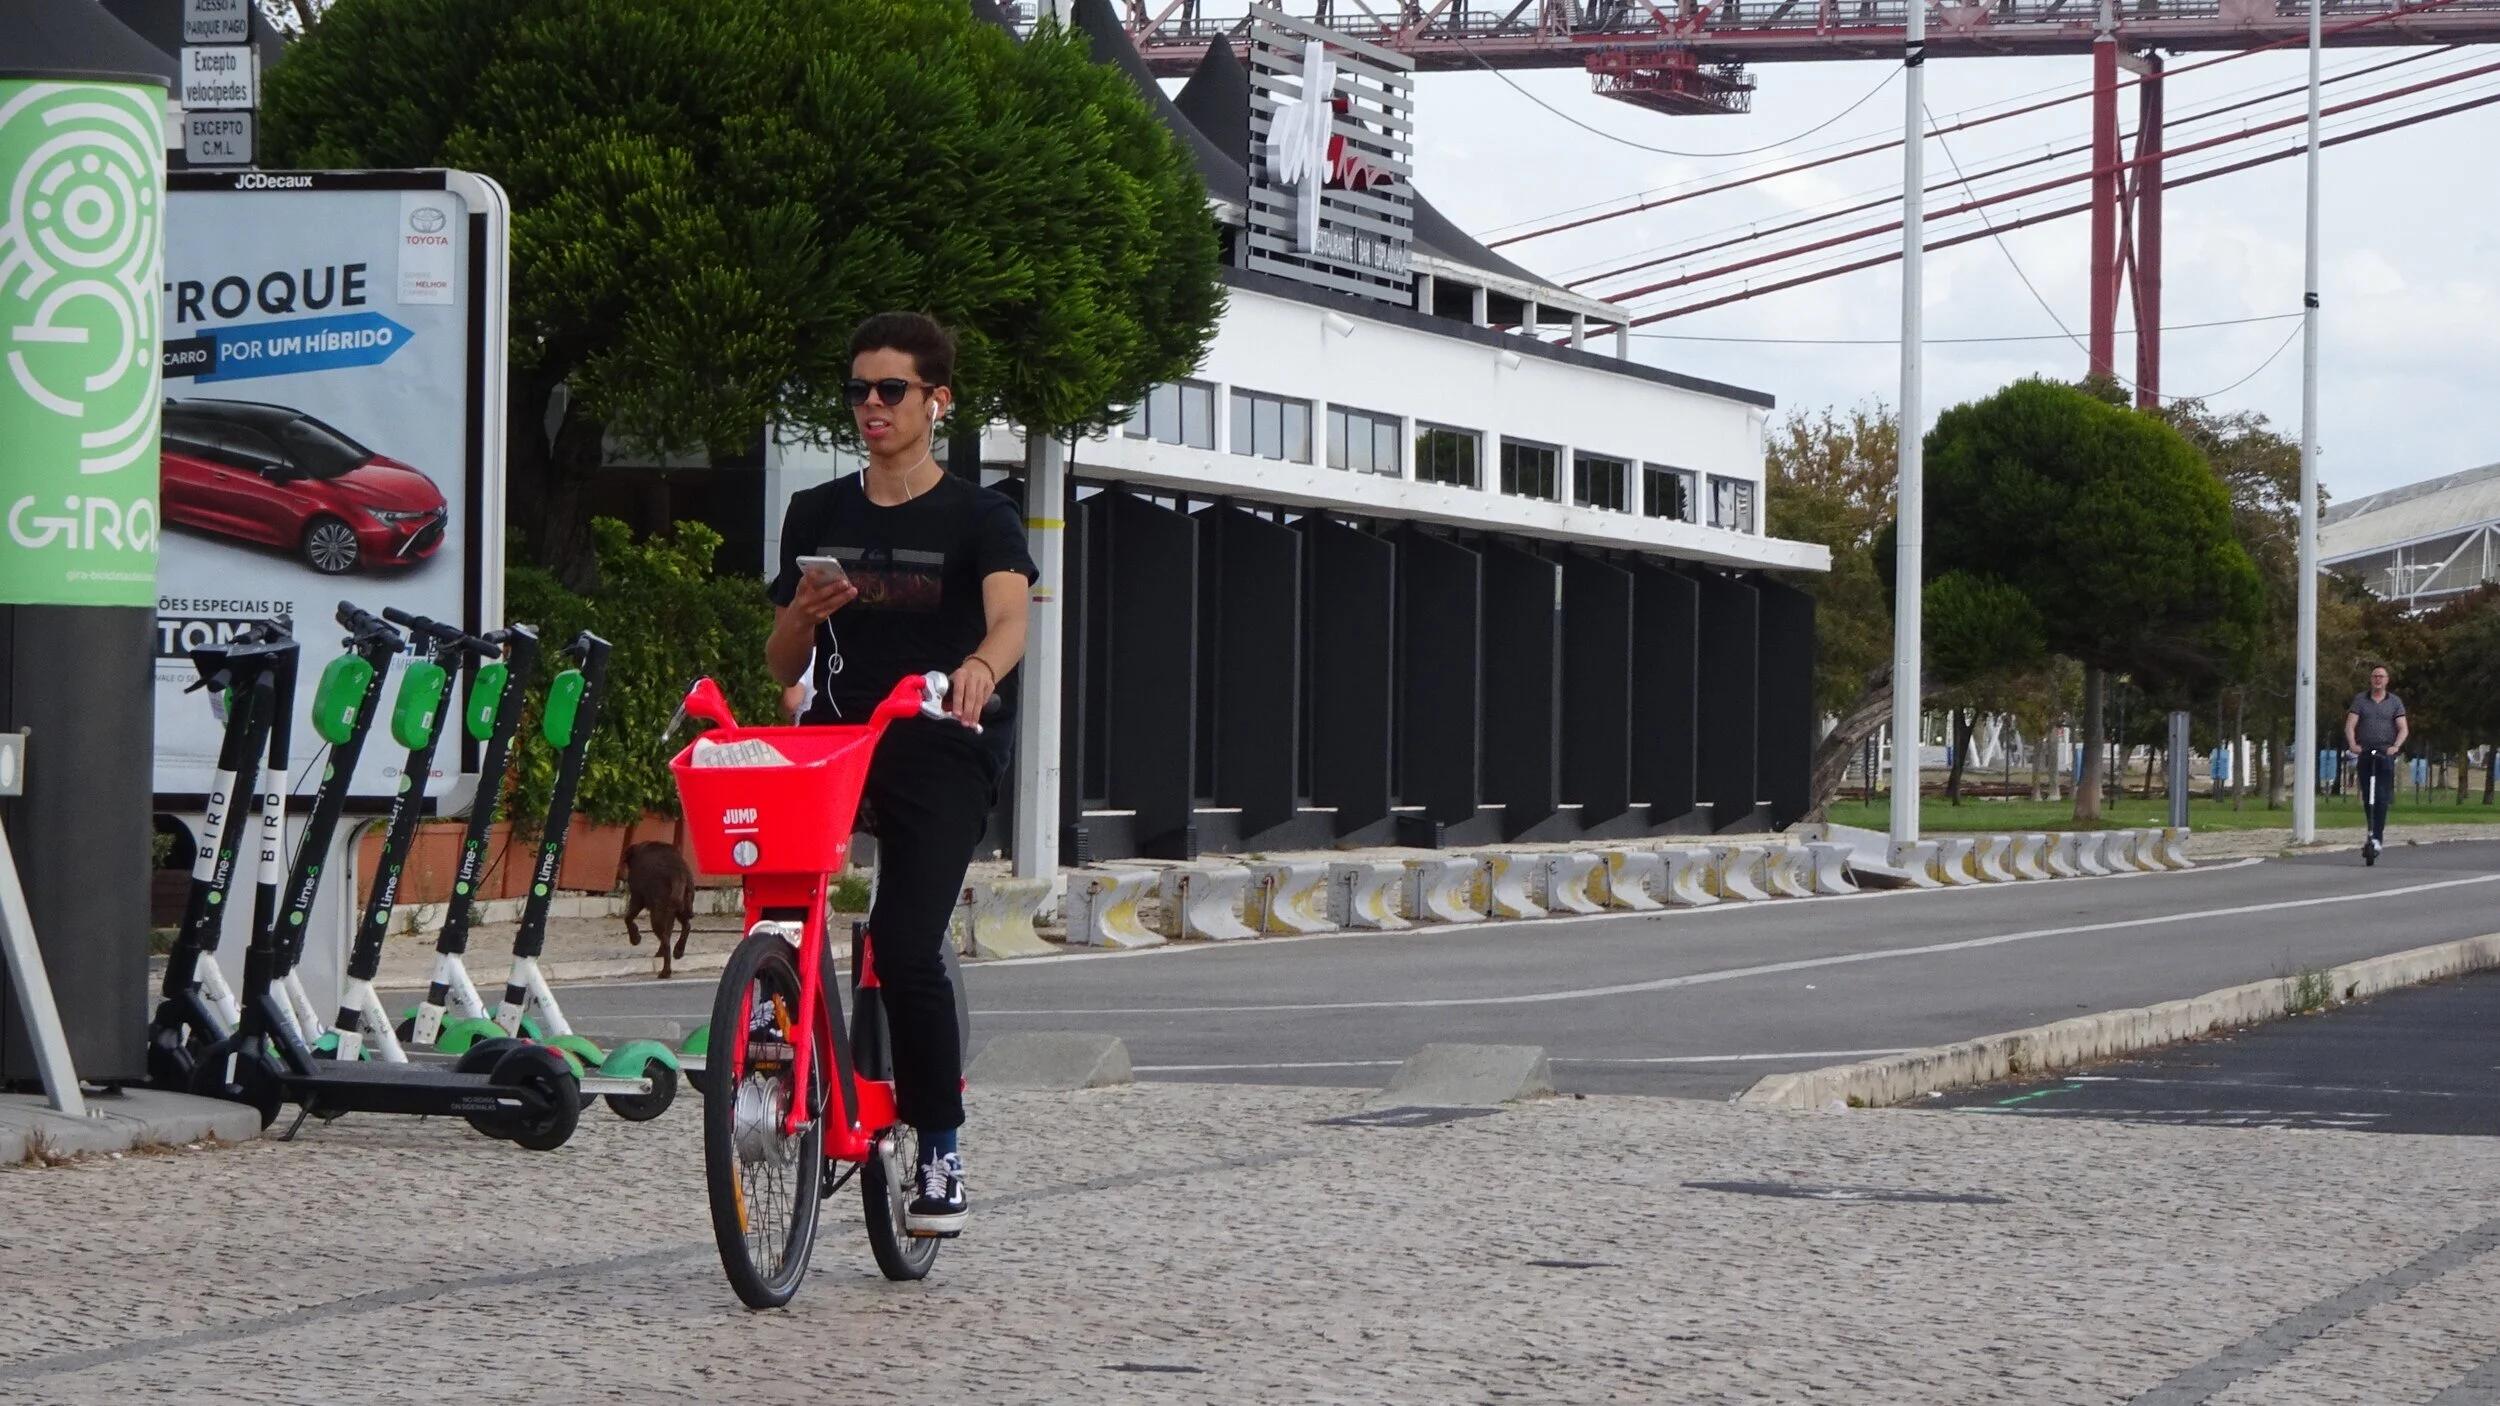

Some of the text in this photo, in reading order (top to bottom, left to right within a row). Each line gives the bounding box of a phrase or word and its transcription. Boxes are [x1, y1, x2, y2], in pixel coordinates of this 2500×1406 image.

[186, 20, 246, 38] PARQUE PAGO
[195, 51, 236, 76] Excepto
[186, 79, 247, 105] velocípedes
[193, 121, 244, 135] EXCEPTO
[203, 141, 235, 155] C.M.L.
[235, 173, 313, 189] JCDecaux
[406, 235, 448, 246] TOYOTA
[163, 327, 392, 365] CARRO POR UM HÍBRIDO
[193, 599, 269, 613] ESPECIAIS
[274, 601, 293, 613] DE
[158, 620, 266, 654] TOM
[723, 808, 758, 824] JUMP
[200, 792, 225, 859] BIRD
[261, 793, 280, 862] BIRD
